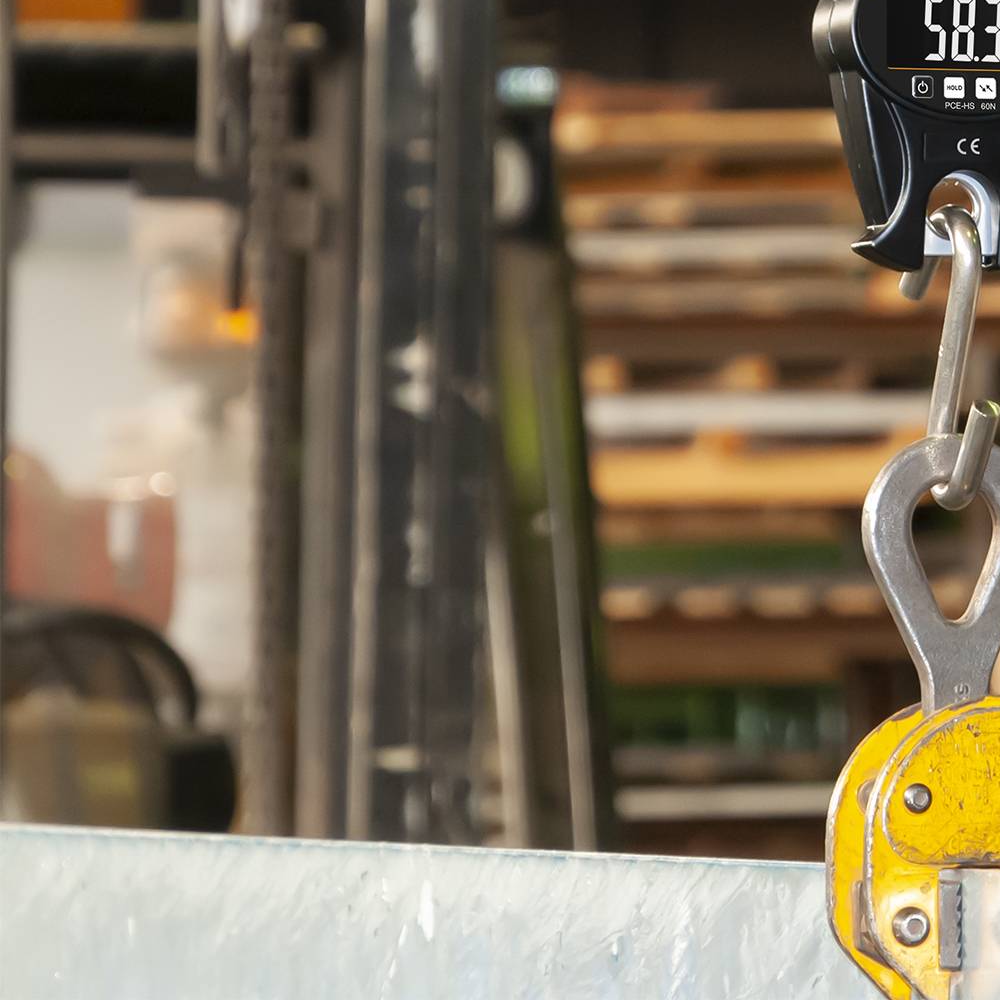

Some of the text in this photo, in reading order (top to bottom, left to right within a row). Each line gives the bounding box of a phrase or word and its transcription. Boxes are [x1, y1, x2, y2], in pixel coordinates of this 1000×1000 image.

[944, 101, 997, 111] PCE-HS 60N
[957, 138, 981, 155] CE
